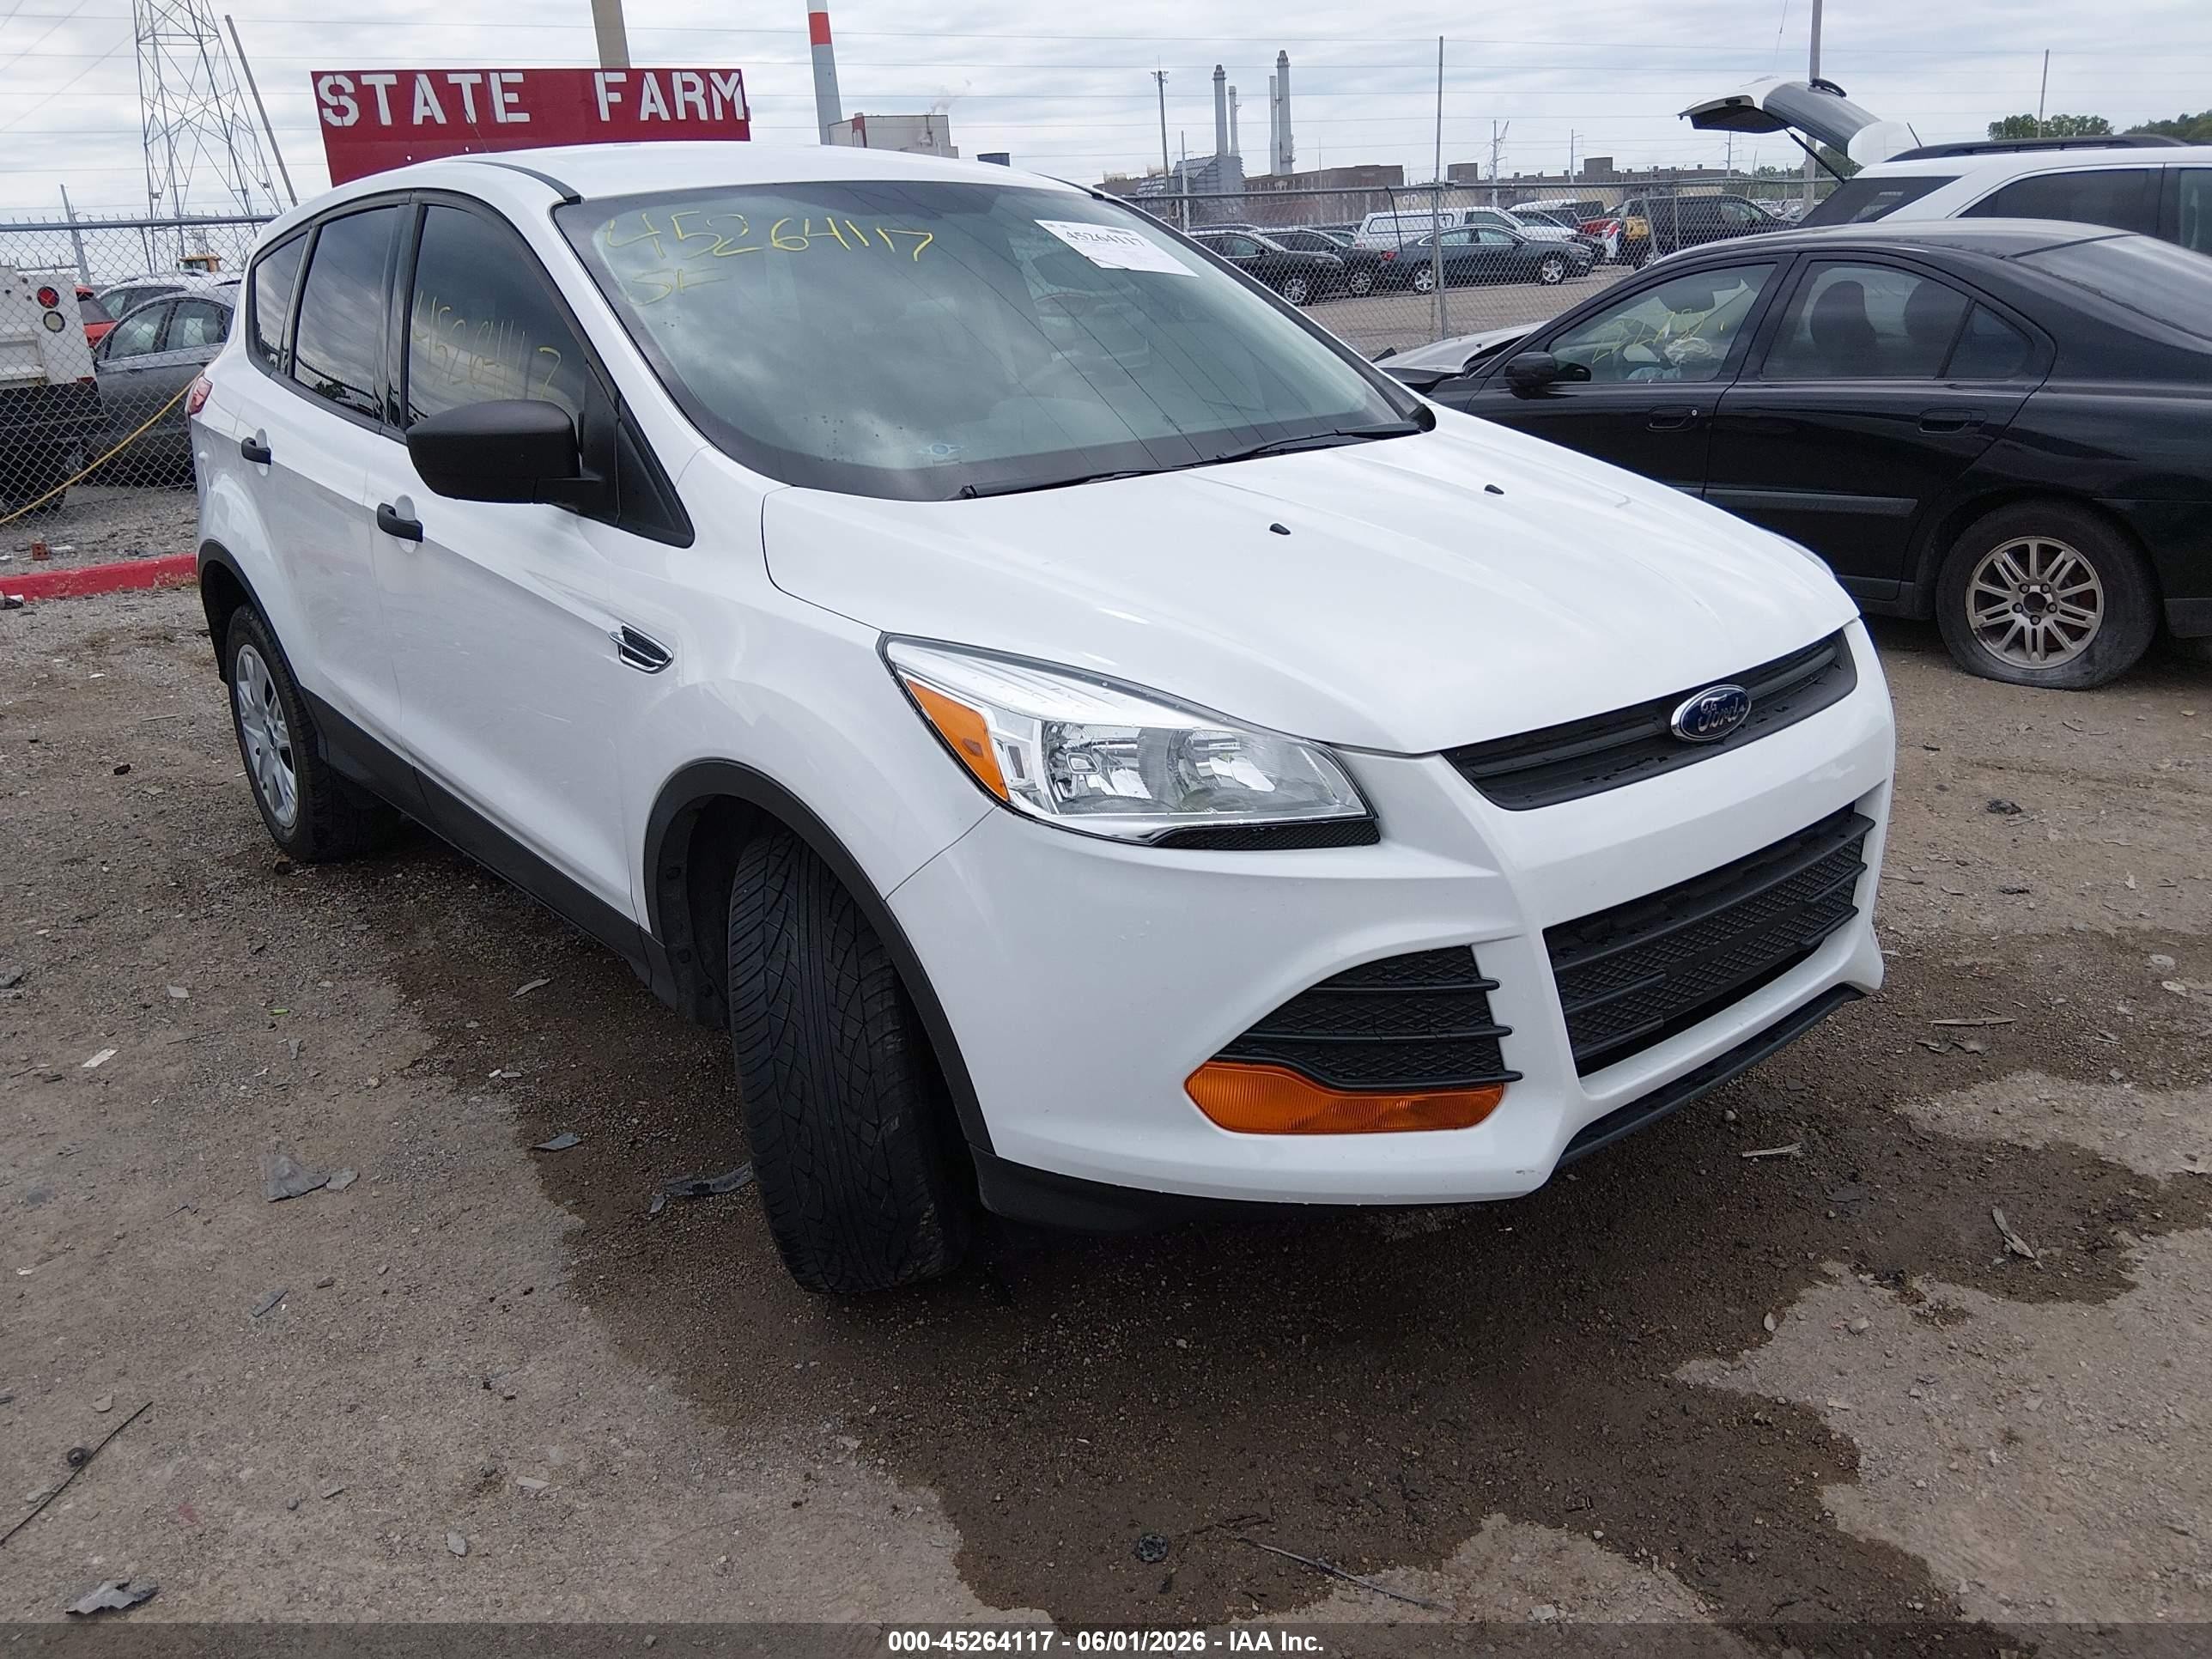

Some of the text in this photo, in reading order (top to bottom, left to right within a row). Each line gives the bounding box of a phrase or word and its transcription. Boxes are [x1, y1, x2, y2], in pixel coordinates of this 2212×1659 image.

[318, 71, 745, 127] STATE FARM
[605, 210, 934, 262] 45264117
[1066, 230, 1146, 247] 45264117
[1698, 694, 1746, 732] Ford
